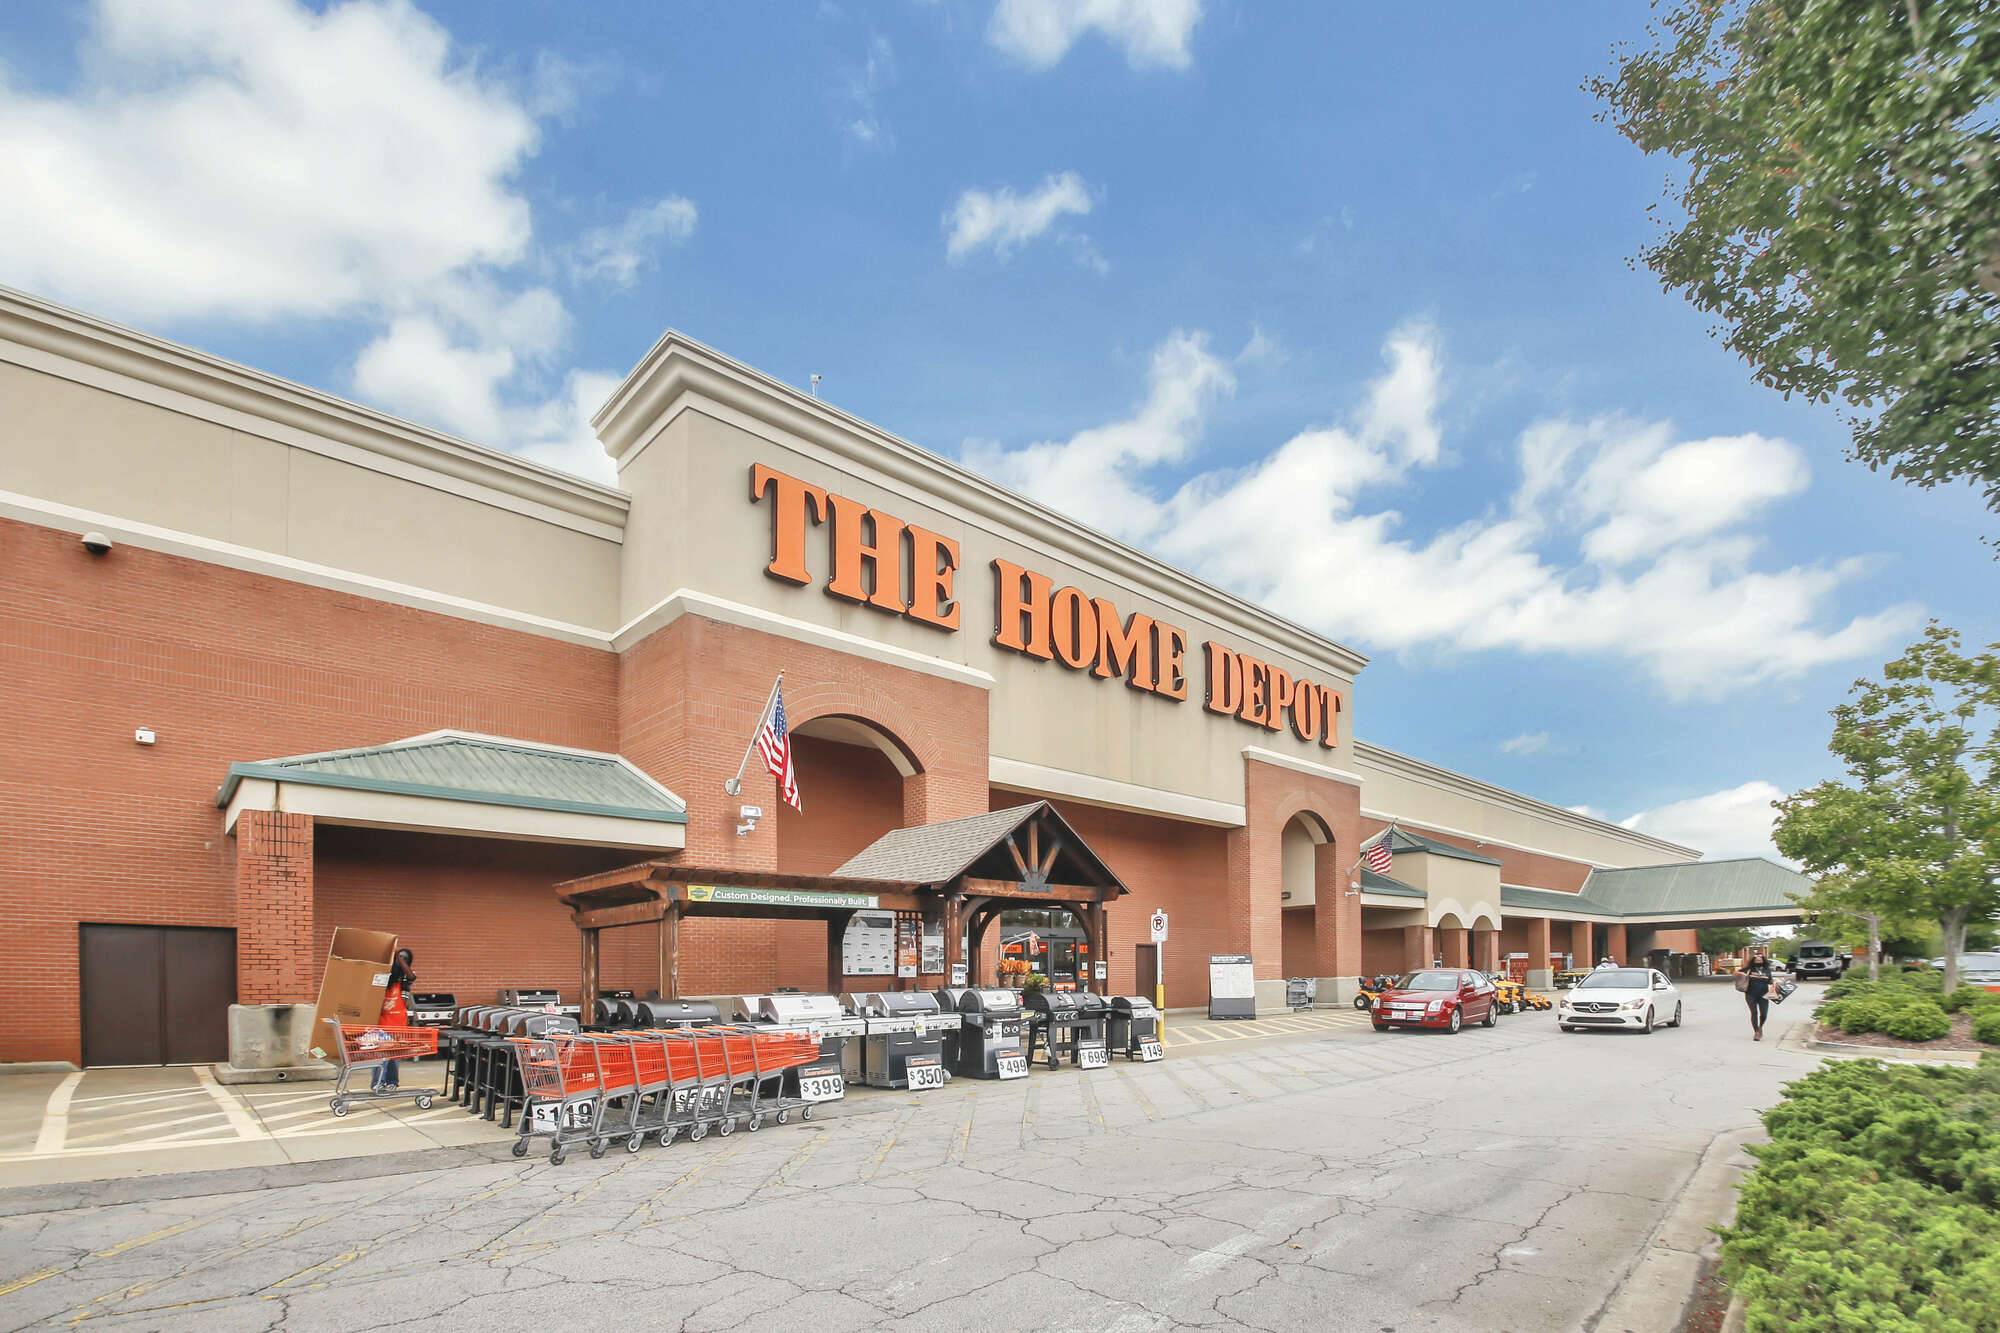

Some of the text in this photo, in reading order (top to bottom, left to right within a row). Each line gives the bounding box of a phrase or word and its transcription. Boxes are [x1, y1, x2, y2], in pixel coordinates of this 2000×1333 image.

[750, 462, 1342, 749] THE HOME DEPOT
[714, 890, 749, 900] Custom
[751, 892, 792, 903] Designed.
[793, 895, 846, 906] Professionally
